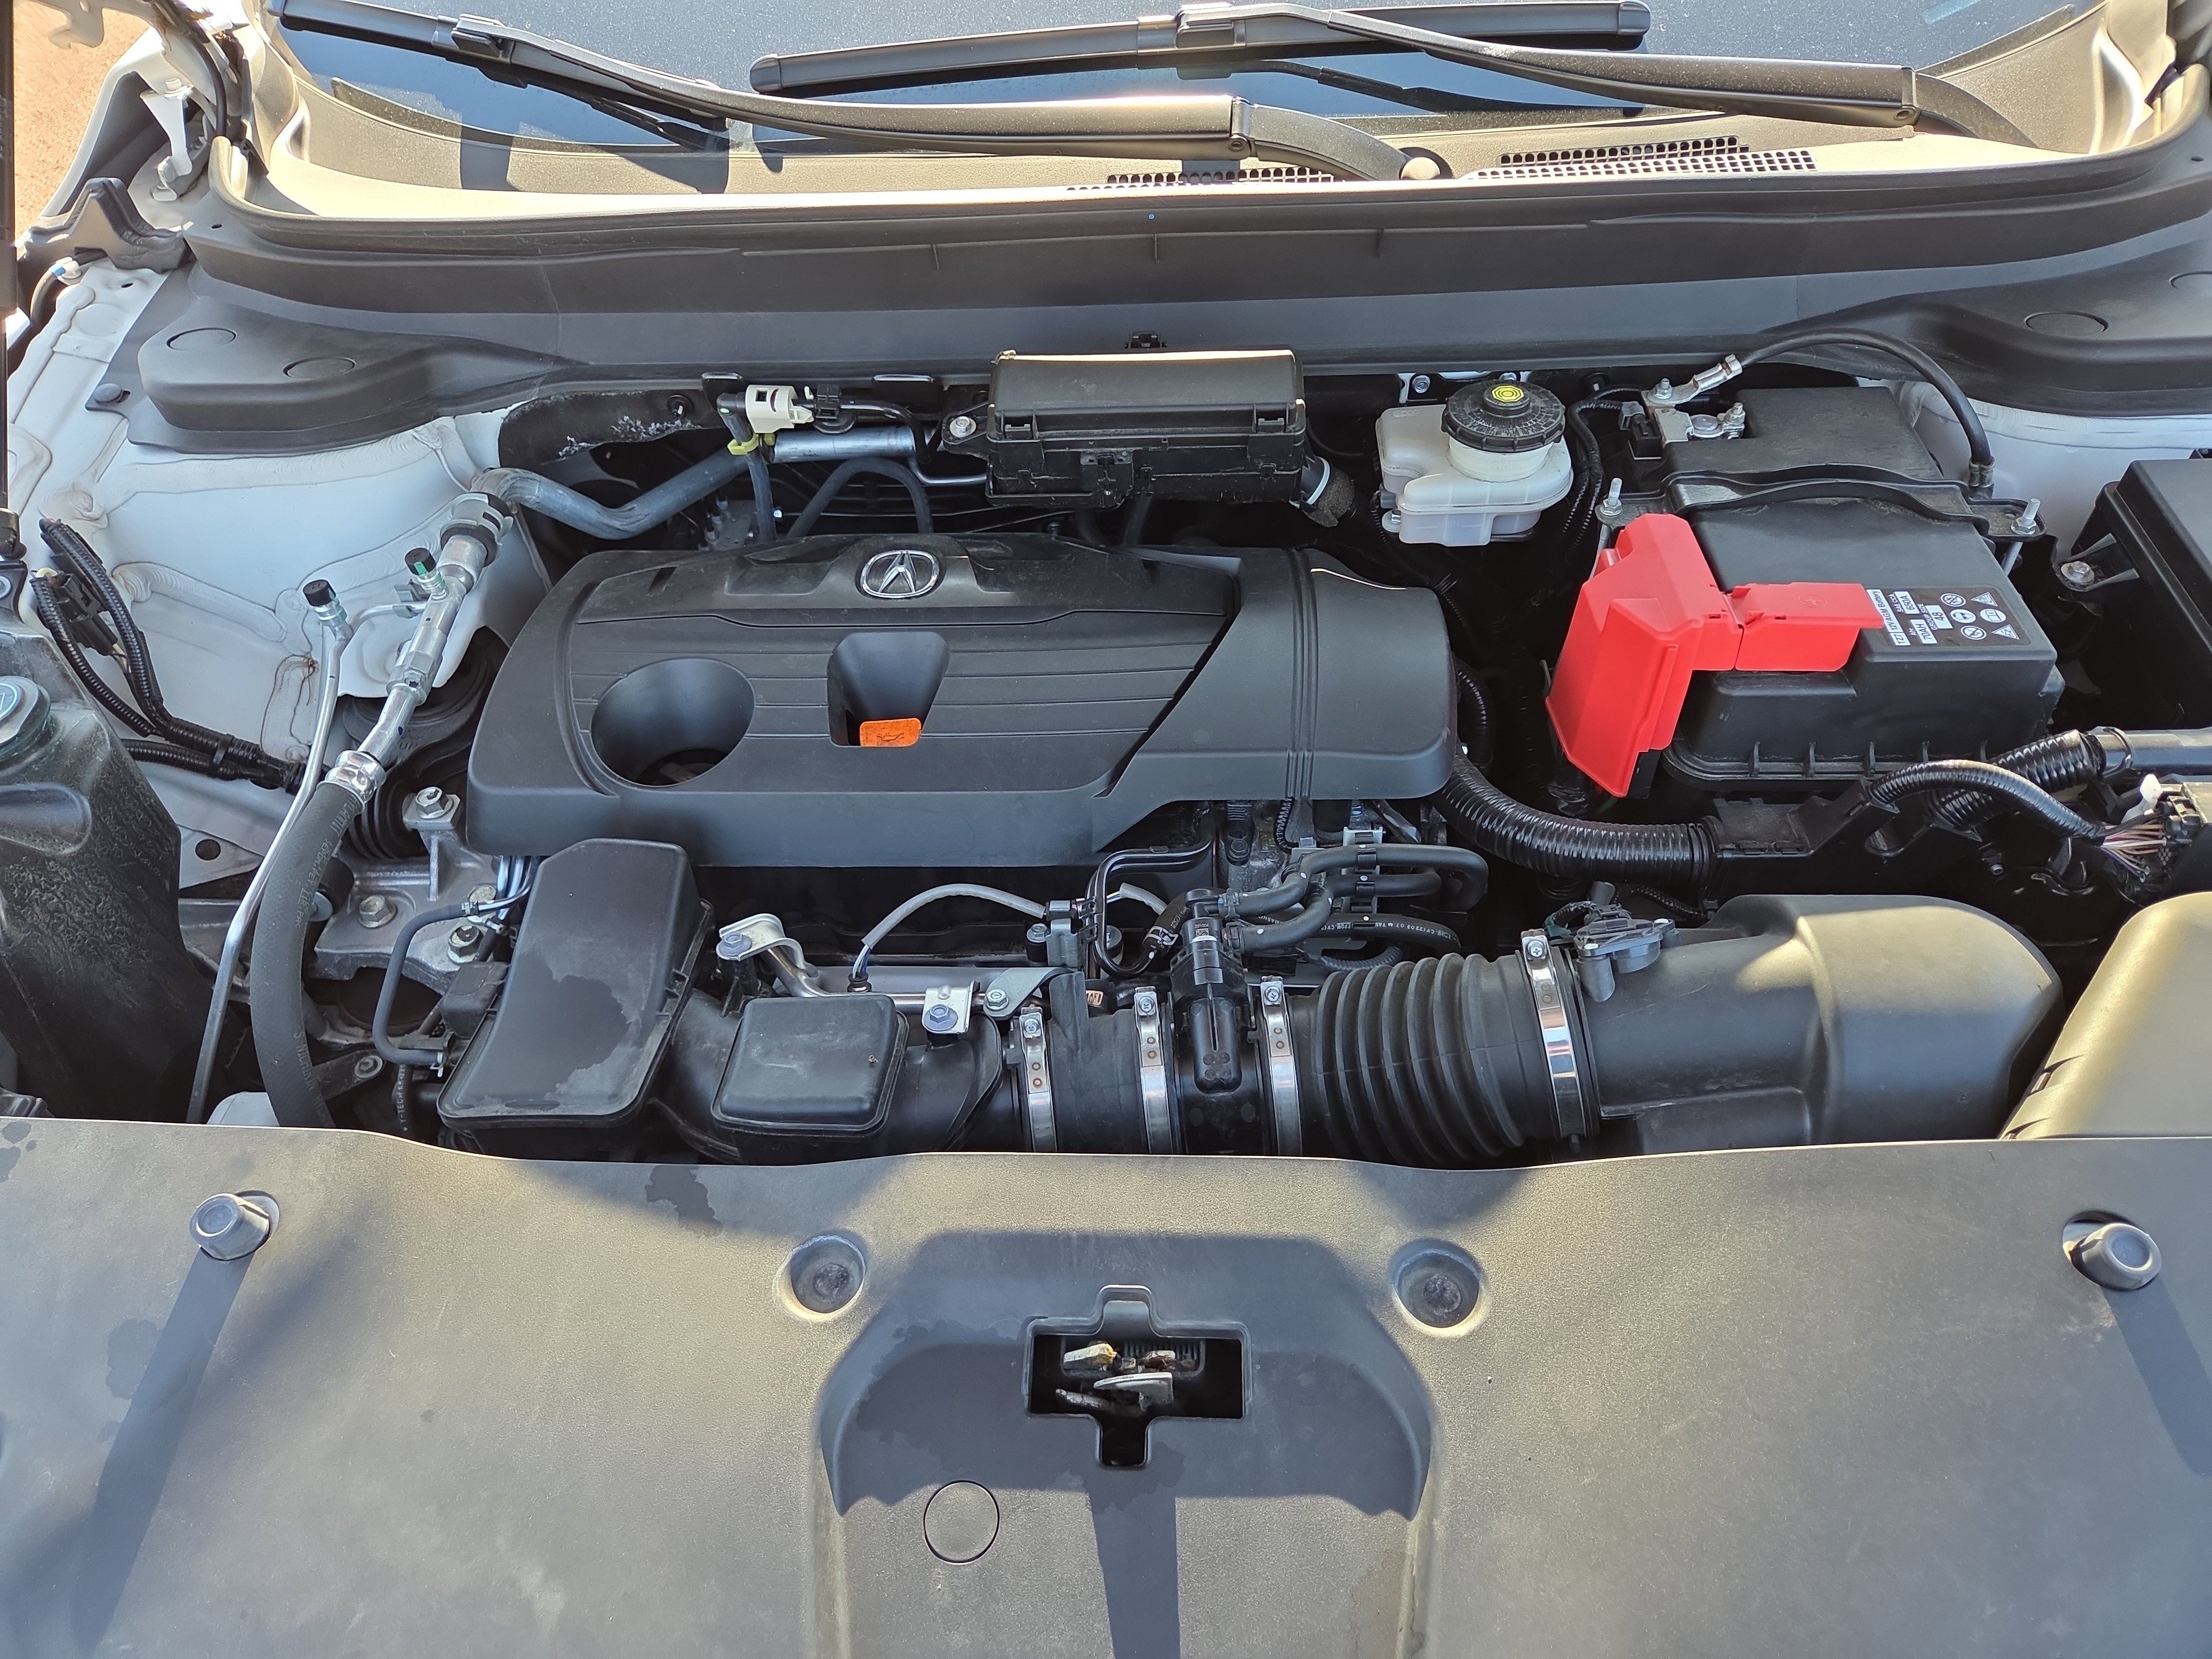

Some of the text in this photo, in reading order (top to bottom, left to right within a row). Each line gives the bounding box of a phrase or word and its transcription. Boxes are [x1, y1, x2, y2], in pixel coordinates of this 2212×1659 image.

[1900, 595, 1915, 610] 650A
[1932, 612, 1945, 621] 48
[1915, 623, 1932, 640] 70AH
